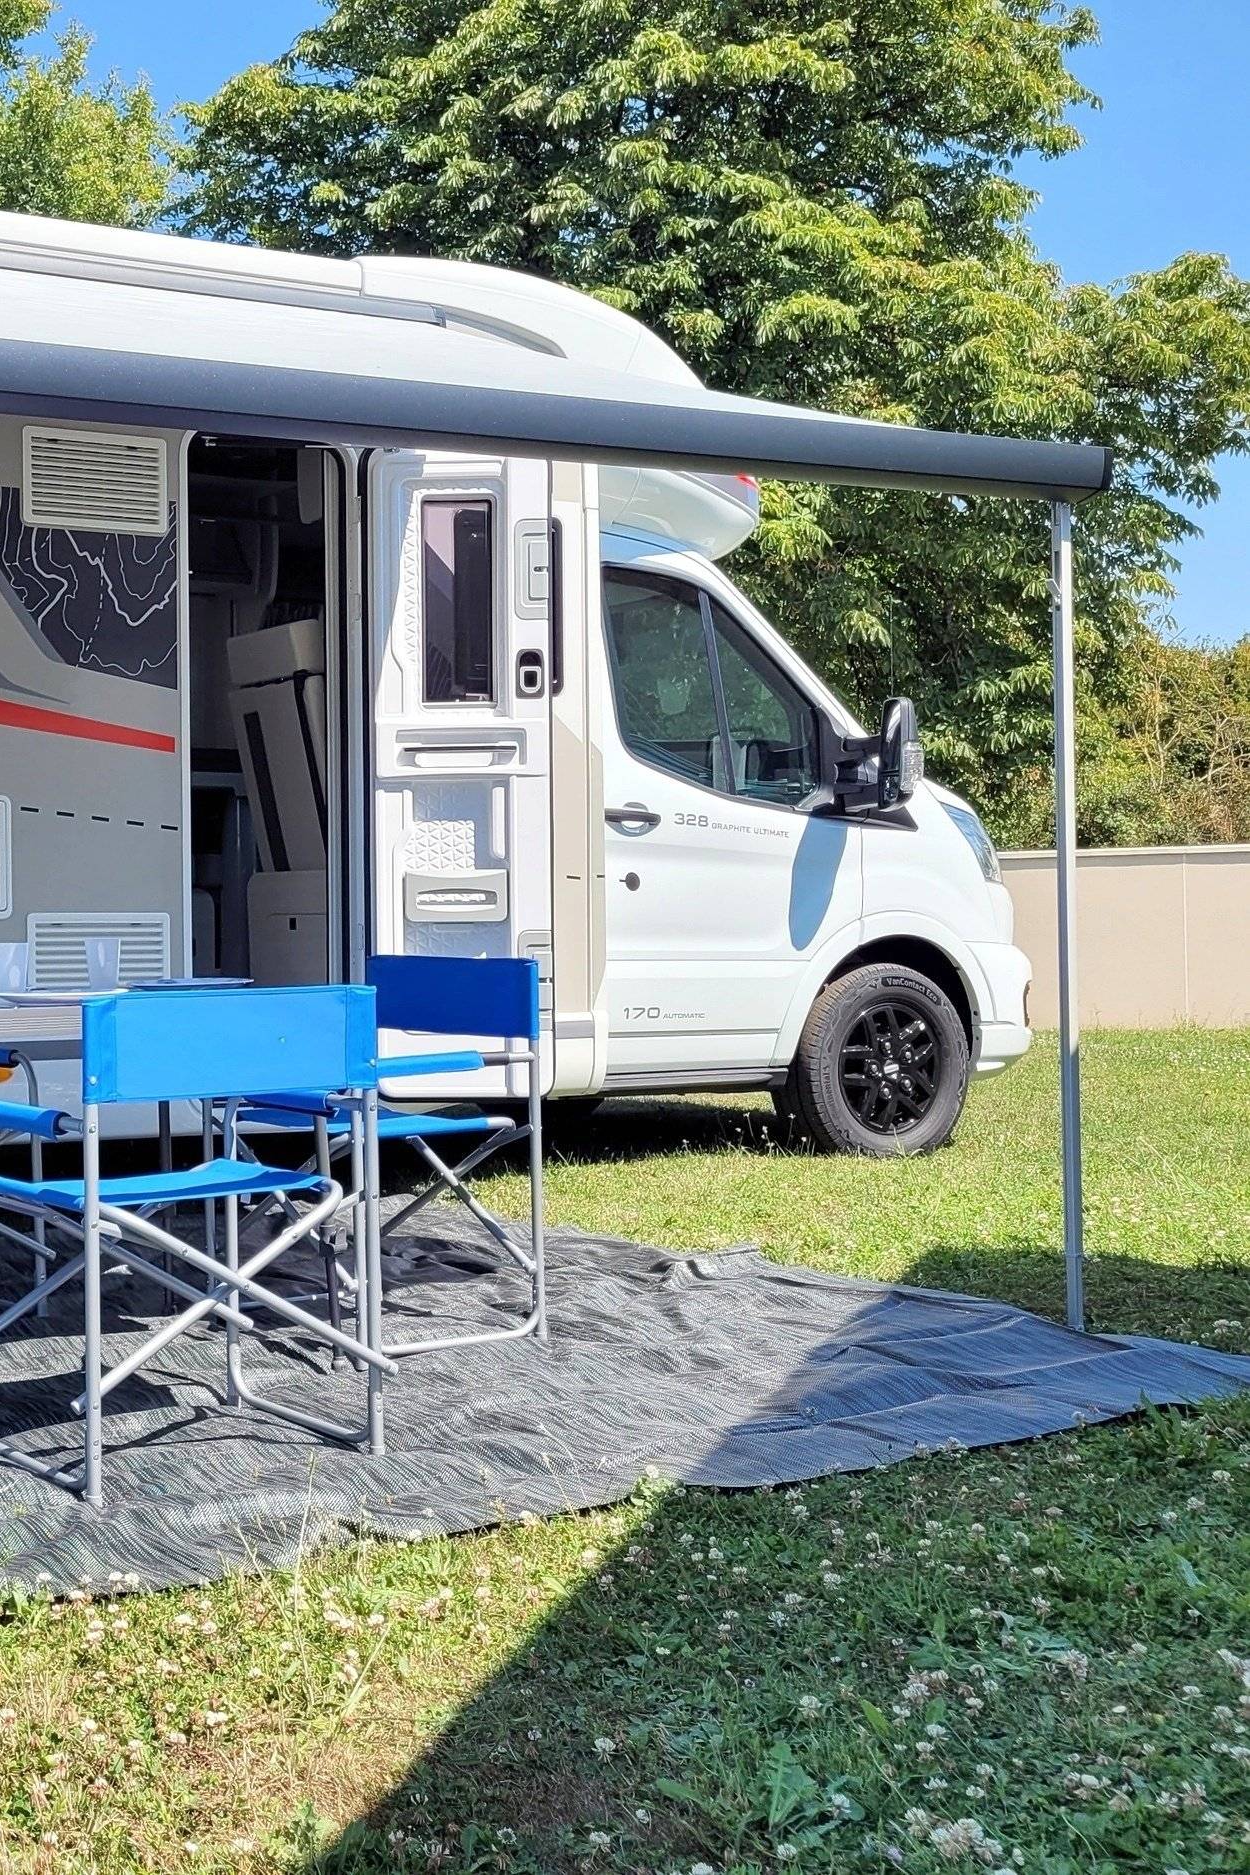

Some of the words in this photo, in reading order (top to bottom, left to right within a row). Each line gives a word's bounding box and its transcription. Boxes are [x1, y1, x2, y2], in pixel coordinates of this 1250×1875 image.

[674, 813, 709, 827] 328
[711, 822, 751, 833] GRAPHITE
[753, 827, 790, 838] ULTIMATE
[623, 1007, 661, 1020] 170
[662, 1012, 706, 1020] AUTOMATIC
